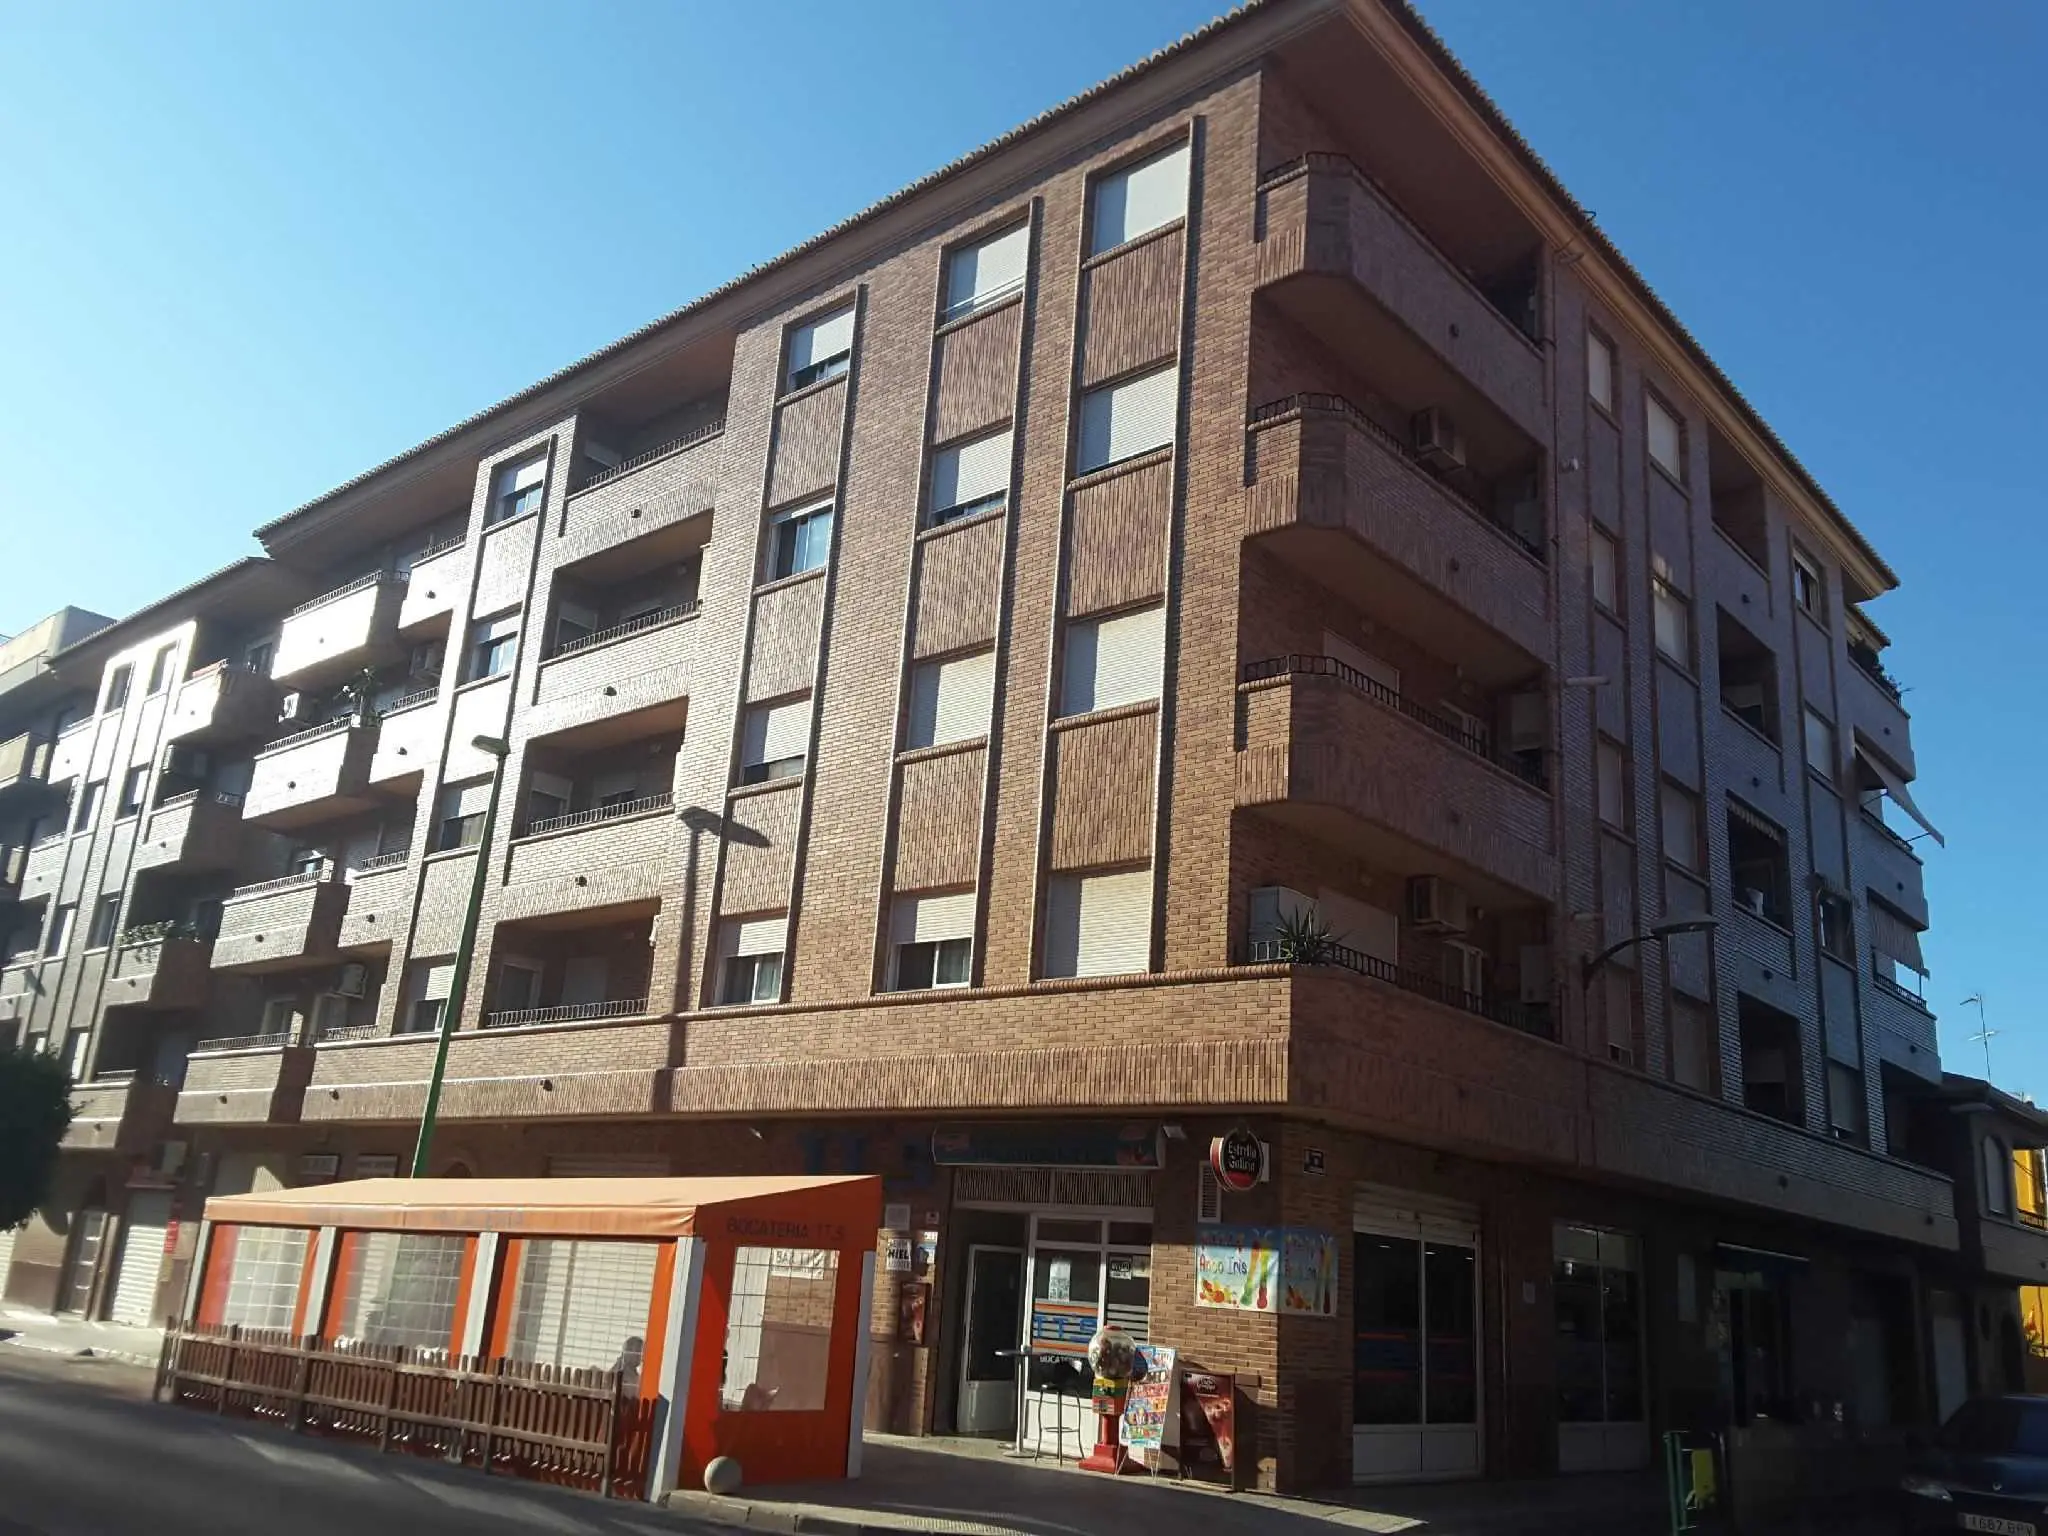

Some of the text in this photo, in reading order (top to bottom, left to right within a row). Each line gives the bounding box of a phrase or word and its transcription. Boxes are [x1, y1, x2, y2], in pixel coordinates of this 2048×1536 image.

[1227, 1141, 1257, 1159] Estrella
[1227, 1156, 1256, 1172] Galicia
[1199, 1253, 1247, 1274] Arco Iris
